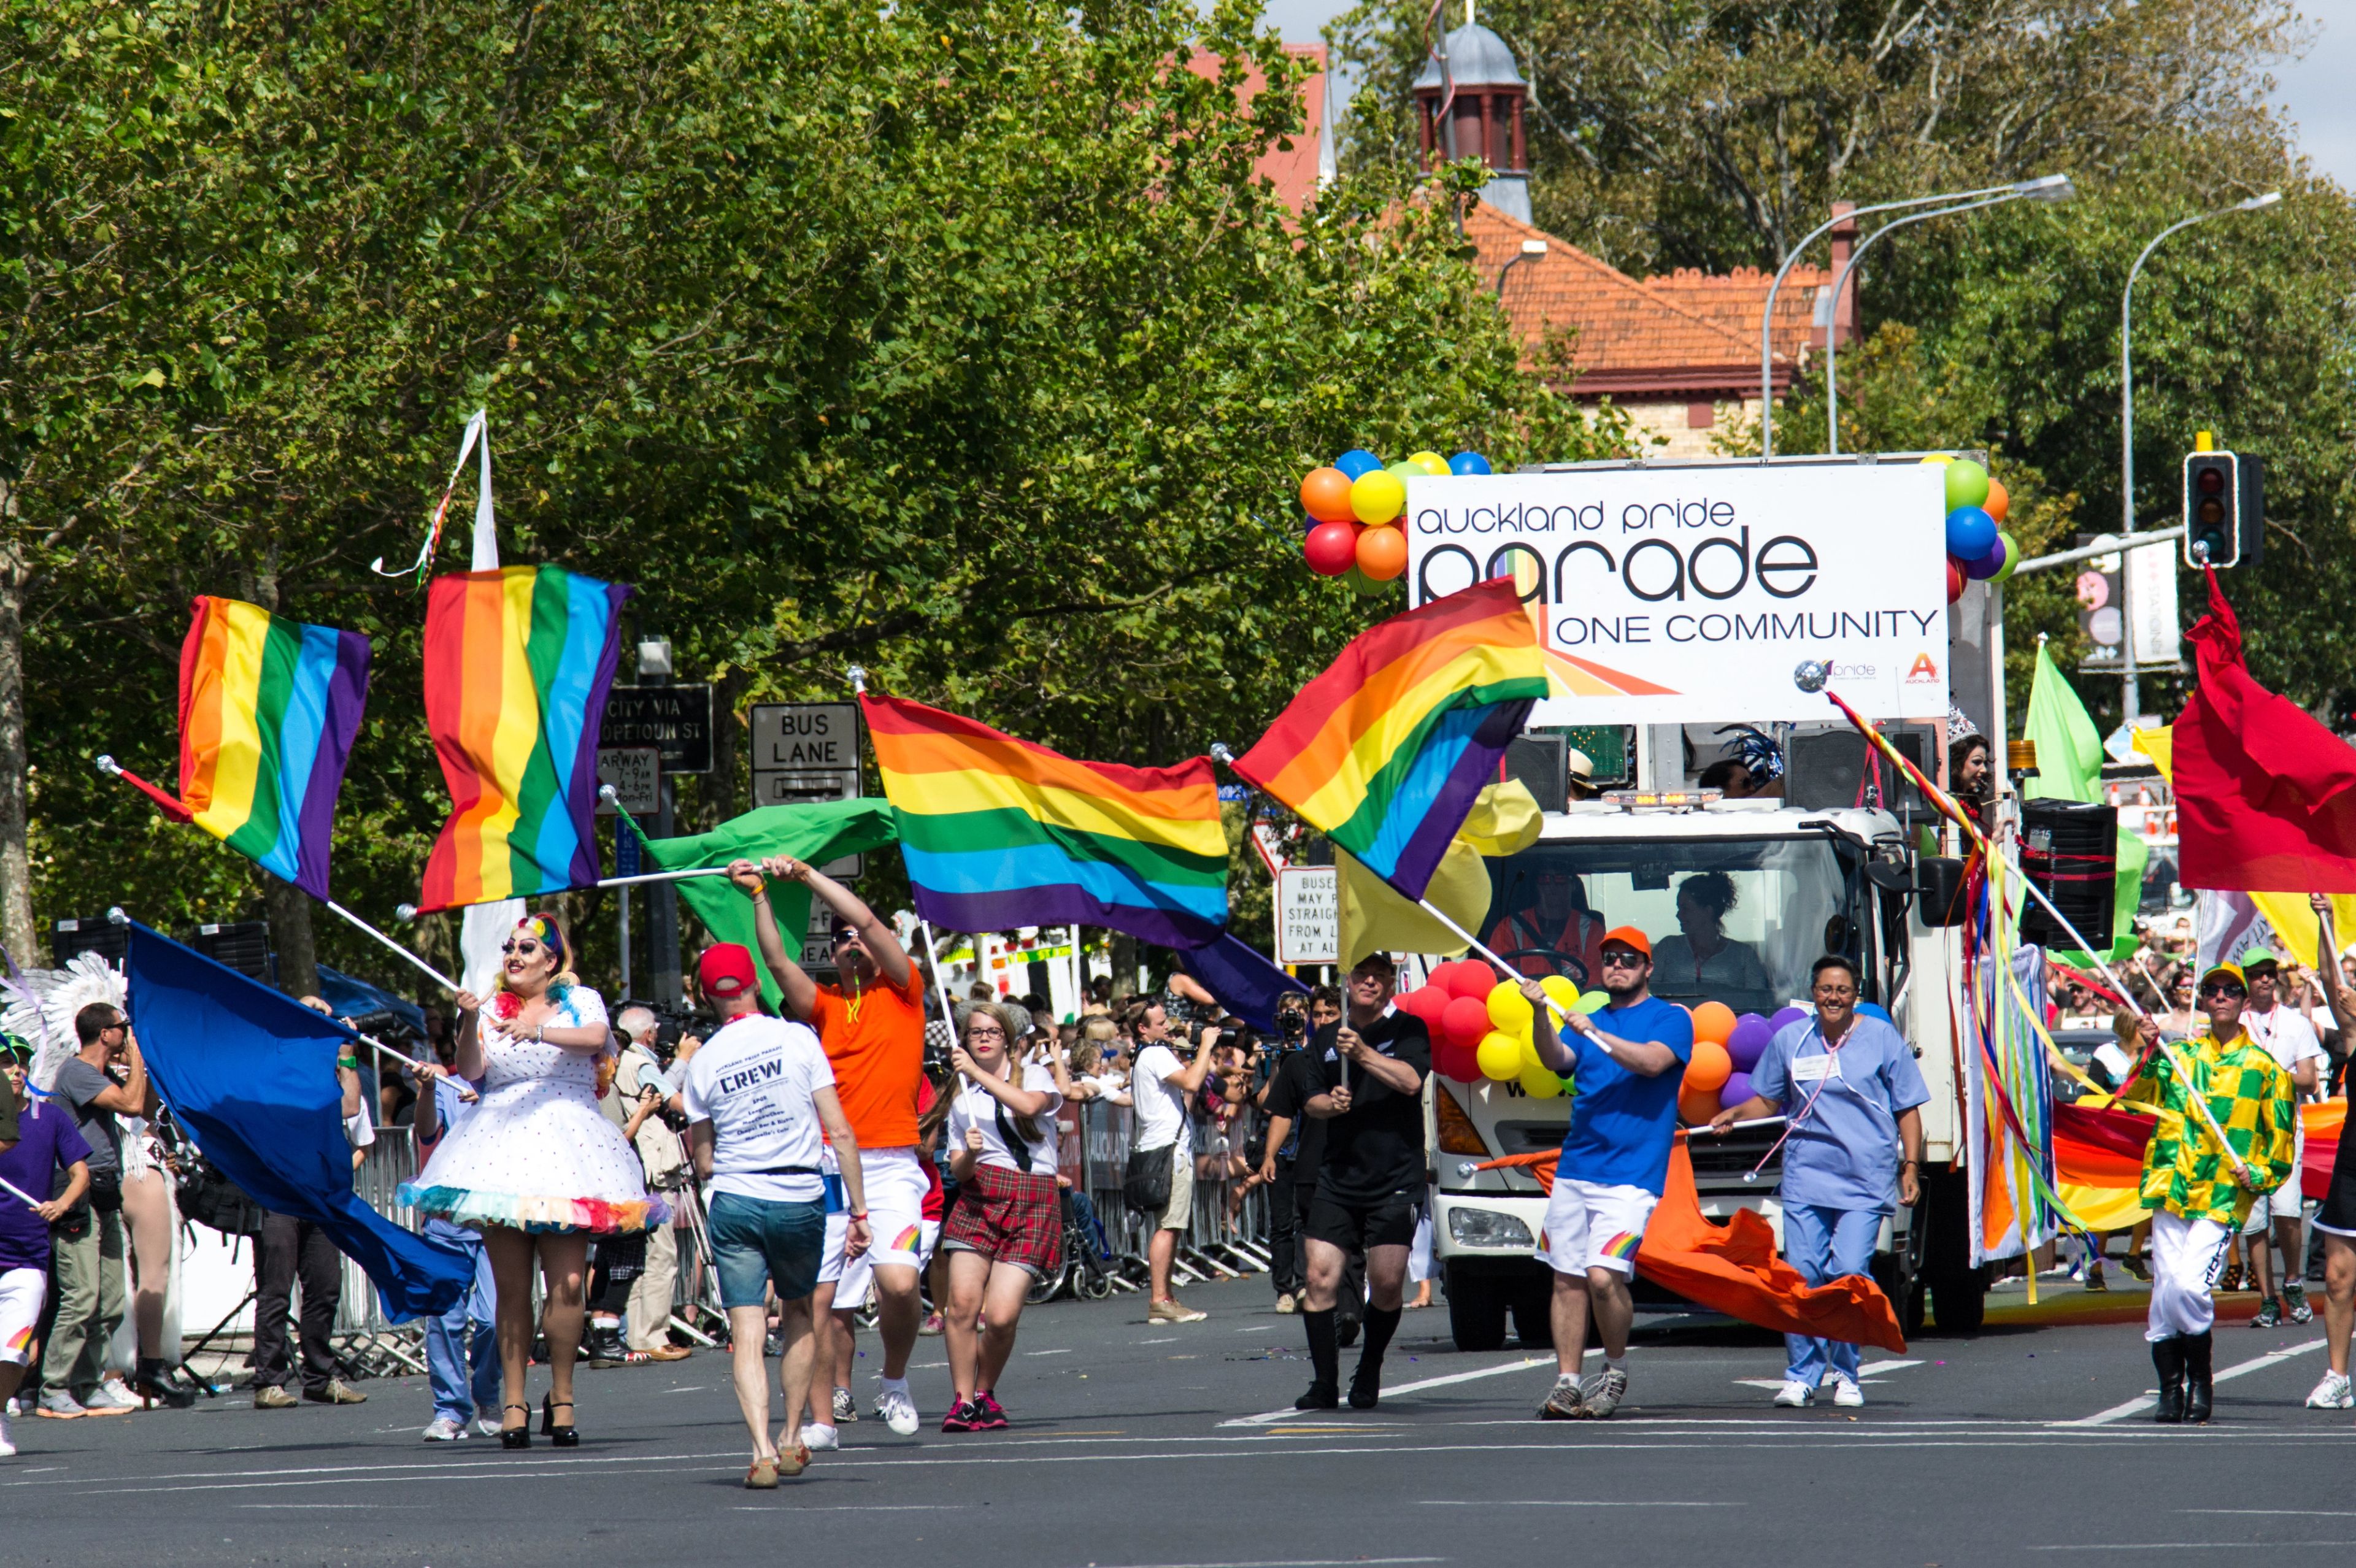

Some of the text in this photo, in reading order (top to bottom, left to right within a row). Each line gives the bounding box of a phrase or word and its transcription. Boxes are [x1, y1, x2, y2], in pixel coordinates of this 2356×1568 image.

[1418, 498, 1735, 534] auckland pride
[1419, 525, 1818, 606] parade
[1557, 609, 1939, 645] ONE COMMUNITY
[1834, 664, 1876, 677] pride
[607, 699, 681, 718] CITY VIA
[601, 722, 701, 742] OPETOUN ST
[782, 713, 828, 736] BUS
[601, 754, 650, 767] ARWAY
[774, 741, 838, 763] LANE
[1302, 877, 1337, 889] BUSE
[1298, 893, 1322, 904] MAY
[1288, 908, 1338, 920] STRAIGH
[1289, 925, 1321, 937] FROM
[1300, 942, 1338, 953] AT AL
[720, 1058, 782, 1094] CREW
[2204, 1229, 2231, 1288] RIDE
